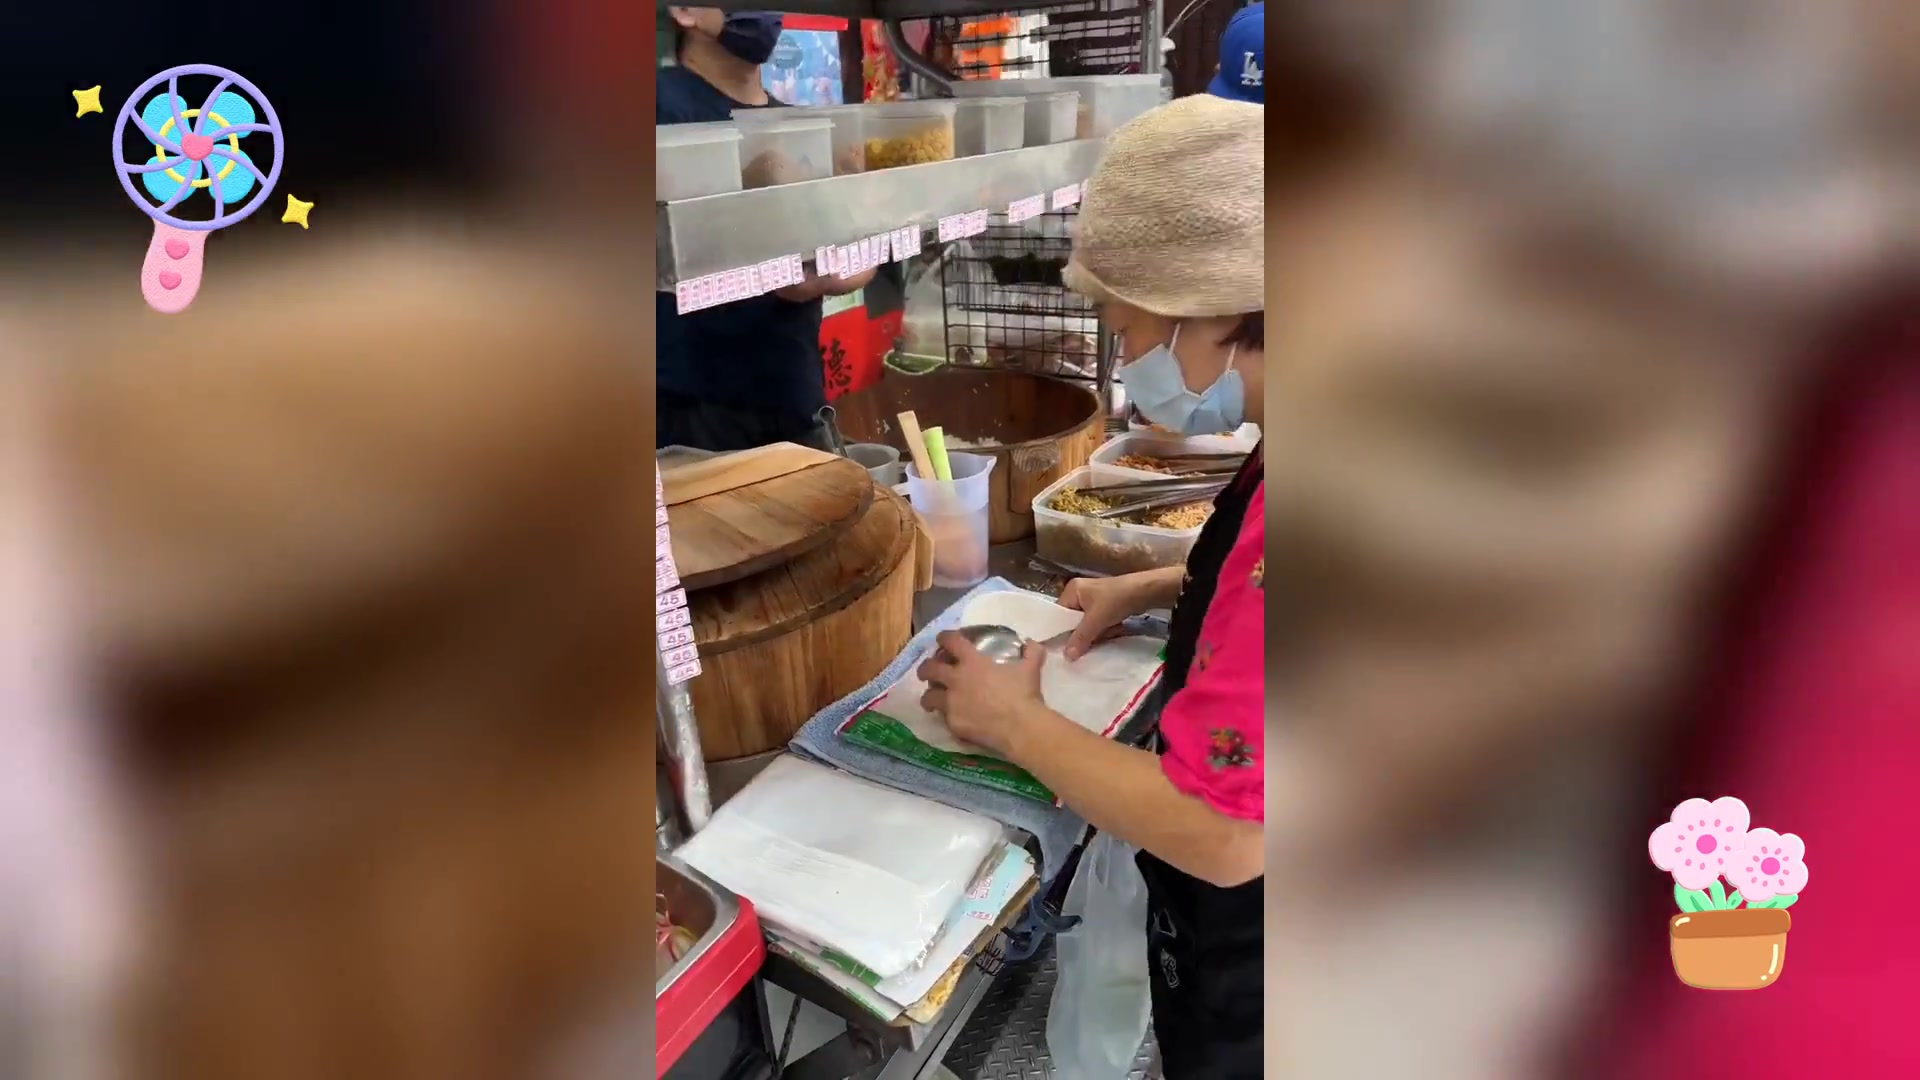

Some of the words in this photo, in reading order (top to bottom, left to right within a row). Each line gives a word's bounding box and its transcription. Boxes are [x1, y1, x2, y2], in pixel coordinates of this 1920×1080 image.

[660, 594, 680, 606] 45
[665, 612, 685, 625] 45
[667, 632, 687, 644] 45
[672, 650, 692, 661] 45
